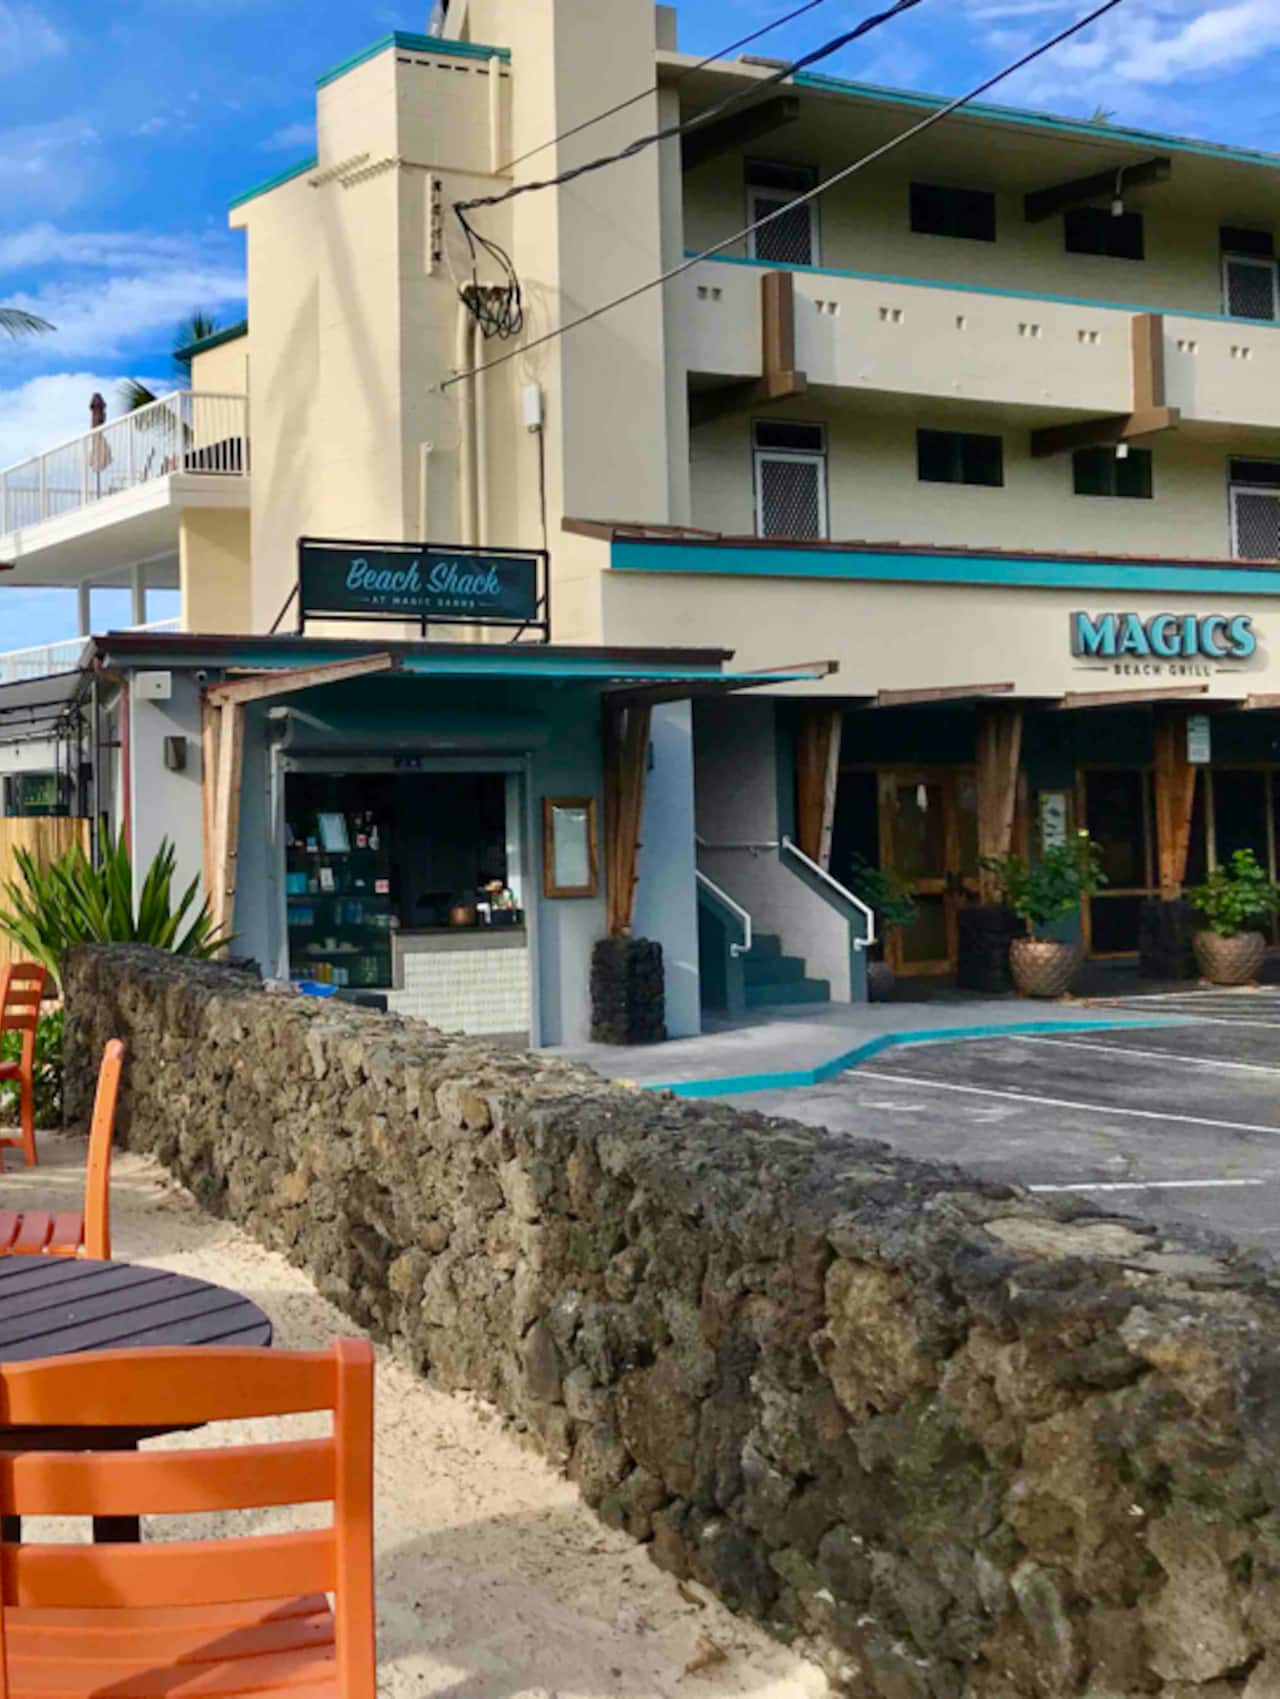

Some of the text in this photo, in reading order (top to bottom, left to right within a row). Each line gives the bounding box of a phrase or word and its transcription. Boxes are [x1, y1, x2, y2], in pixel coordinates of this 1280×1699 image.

[345, 557, 502, 595] Beach Shack
[1071, 611, 1258, 657] MAGICS
[1114, 663, 1211, 677] BEACH GRILL
